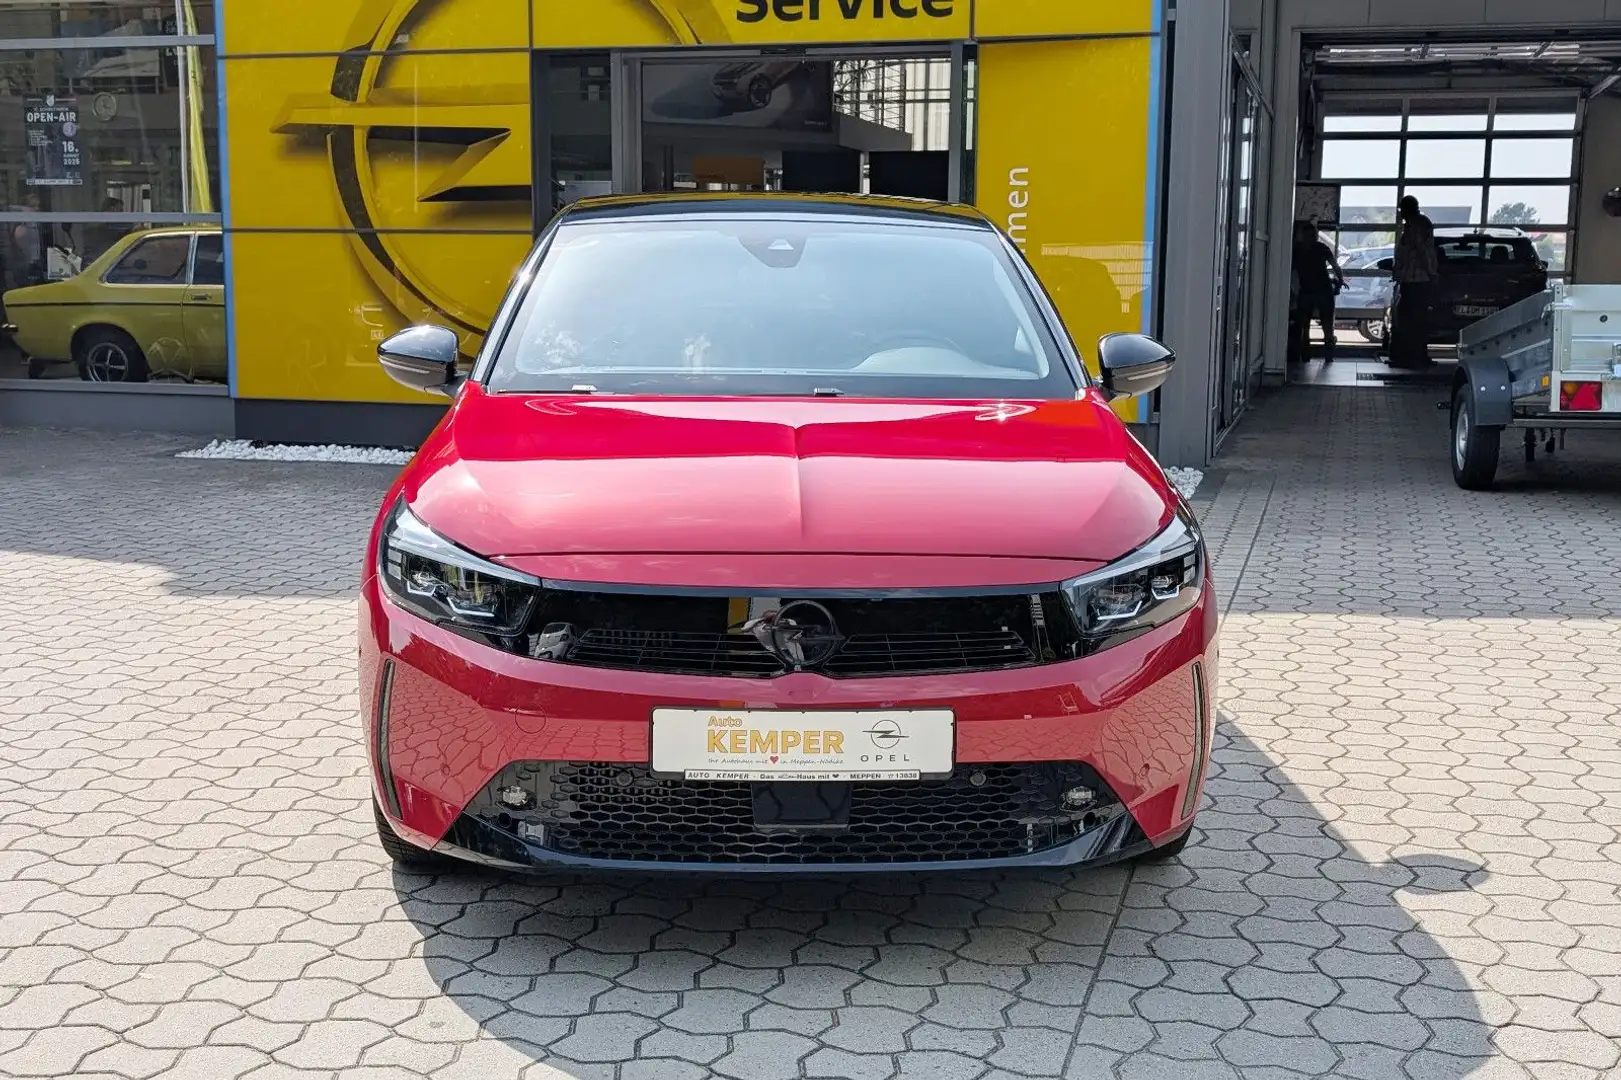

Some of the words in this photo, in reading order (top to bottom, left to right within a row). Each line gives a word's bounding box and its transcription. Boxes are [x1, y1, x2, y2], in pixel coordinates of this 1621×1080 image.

[27, 112, 76, 122] OPEN-AIR
[708, 715, 743, 728] Auto
[707, 729, 845, 754] KEMPER
[860, 753, 910, 762] OPEL
[687, 771, 710, 779] AUTO
